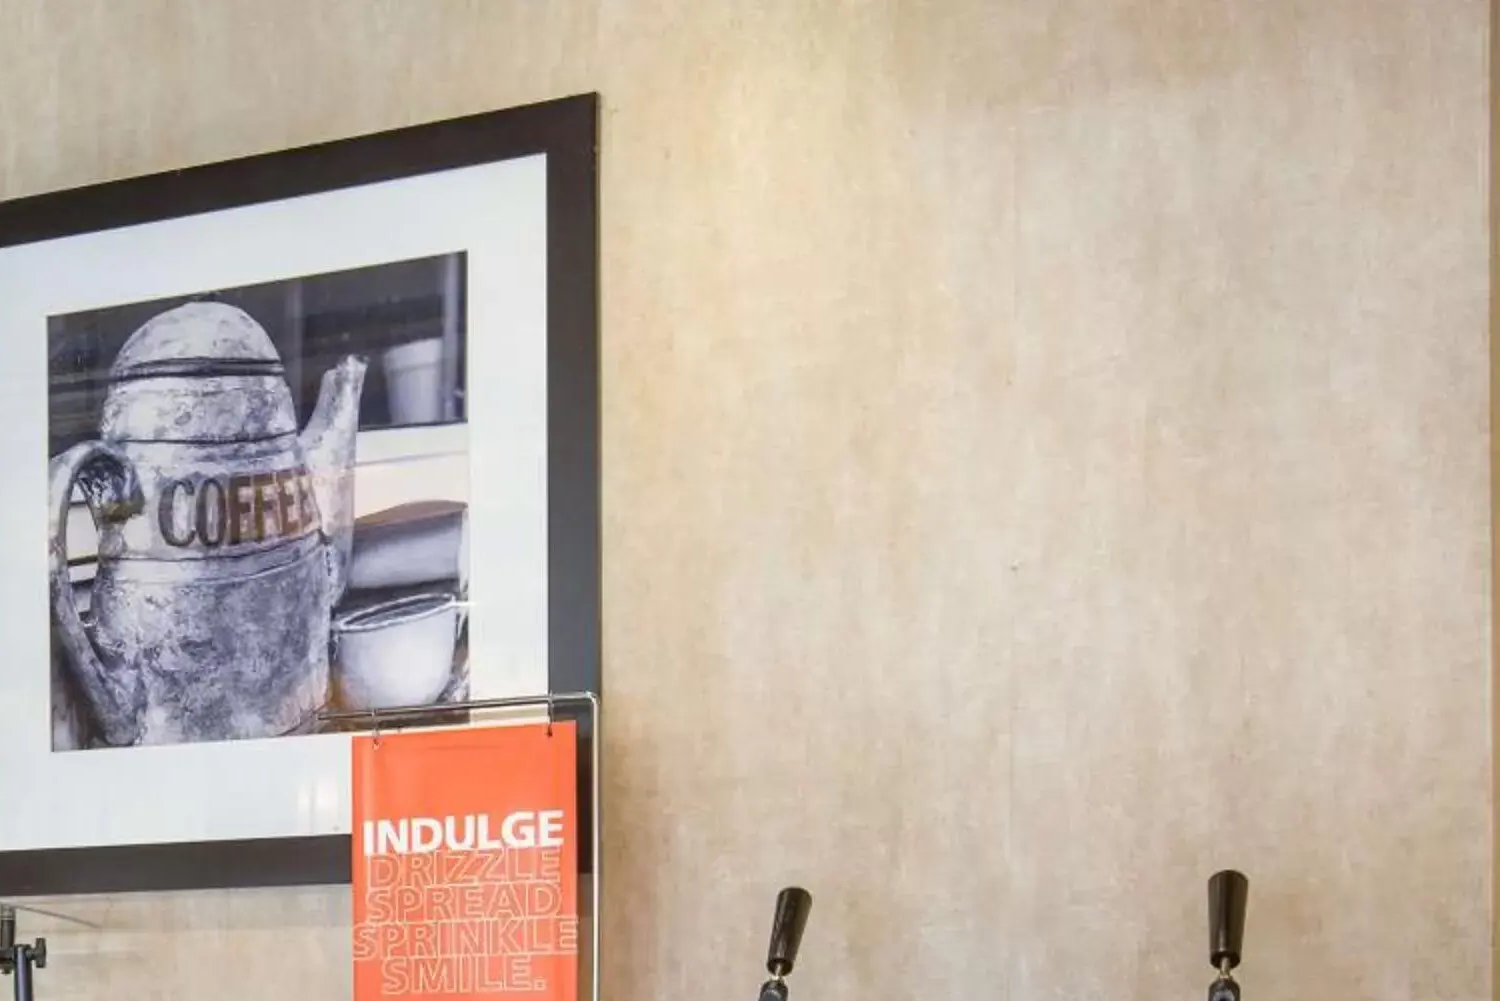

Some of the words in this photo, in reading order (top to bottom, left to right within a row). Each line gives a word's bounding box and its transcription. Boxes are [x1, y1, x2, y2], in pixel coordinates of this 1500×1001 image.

[158, 469, 317, 547] COFFEE
[364, 810, 564, 857] INDULGE
[368, 846, 561, 891] DRIZZLE
[366, 880, 562, 926] SPREAD
[352, 914, 579, 961] SPRINKLE
[381, 954, 547, 995] SMILE.
